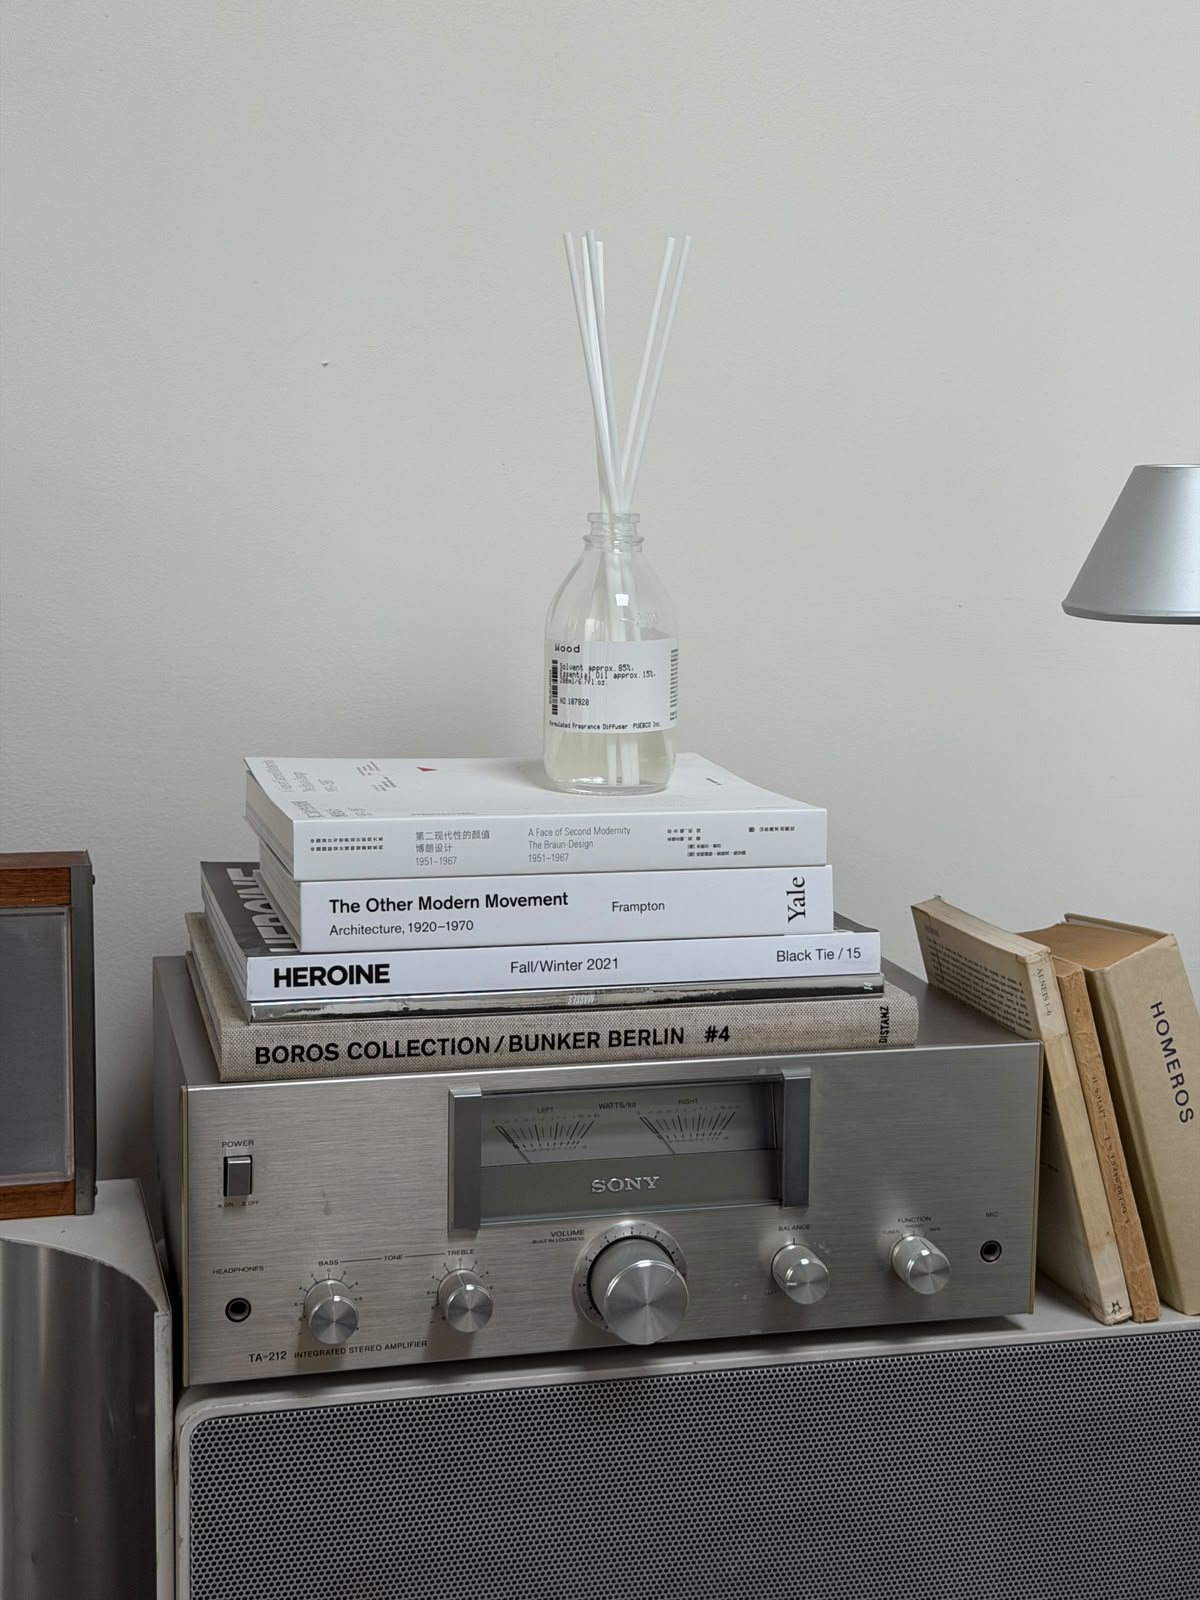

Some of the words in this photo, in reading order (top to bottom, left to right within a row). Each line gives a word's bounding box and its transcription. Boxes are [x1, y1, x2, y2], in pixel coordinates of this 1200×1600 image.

[555, 643, 580, 653] Wood
[559, 663, 583, 671] Solvent
[559, 670, 591, 680] Essential
[595, 671, 608, 679] Oil
[572, 722, 600, 730] Fragrance
[415, 829, 490, 841] 第二现代性的颜值
[528, 828, 534, 837] A
[536, 827, 553, 837] Face
[555, 827, 563, 836] of
[564, 826, 592, 836] Second
[593, 826, 631, 836] Modernity
[415, 842, 453, 854] 博朗设计
[528, 840, 542, 849] The
[544, 839, 594, 850] Braun-Design
[329, 899, 361, 914] The
[366, 897, 413, 913] Other
[418, 894, 480, 911] Modern
[485, 892, 569, 909] Movement
[786, 876, 806, 923] Yale
[611, 901, 665, 914] Frampton
[329, 923, 405, 936] Architecture,
[776, 949, 812, 962] Black
[815, 948, 835, 961] Tie
[846, 946, 862, 959] 15
[510, 959, 583, 975] Fall/Winter
[586, 957, 619, 972] 2021
[273, 963, 391, 989] HEROINE
[879, 1005, 890, 1044] DISTANZ
[255, 1042, 340, 1065] BOROS
[607, 1027, 685, 1048] BERLIN
[704, 1025, 731, 1043] #4
[1150, 1001, 1194, 1123] HOMEROS
[221, 1139, 255, 1148] POWER
[591, 1176, 660, 1193] SONY
[897, 1215, 932, 1223] FUNCTION
[550, 1228, 585, 1238] VOLUME
[778, 1223, 811, 1232] BALANCE
[447, 1248, 475, 1256] TREBLE
[318, 1259, 339, 1267] BASS
[212, 1265, 265, 1275] HEADPHONES
[248, 1350, 288, 1363] TA-212
[294, 1347, 347, 1359] INTEGRATED
[348, 1344, 382, 1354] STEREO
[384, 1340, 428, 1351] AMPLIFIER
